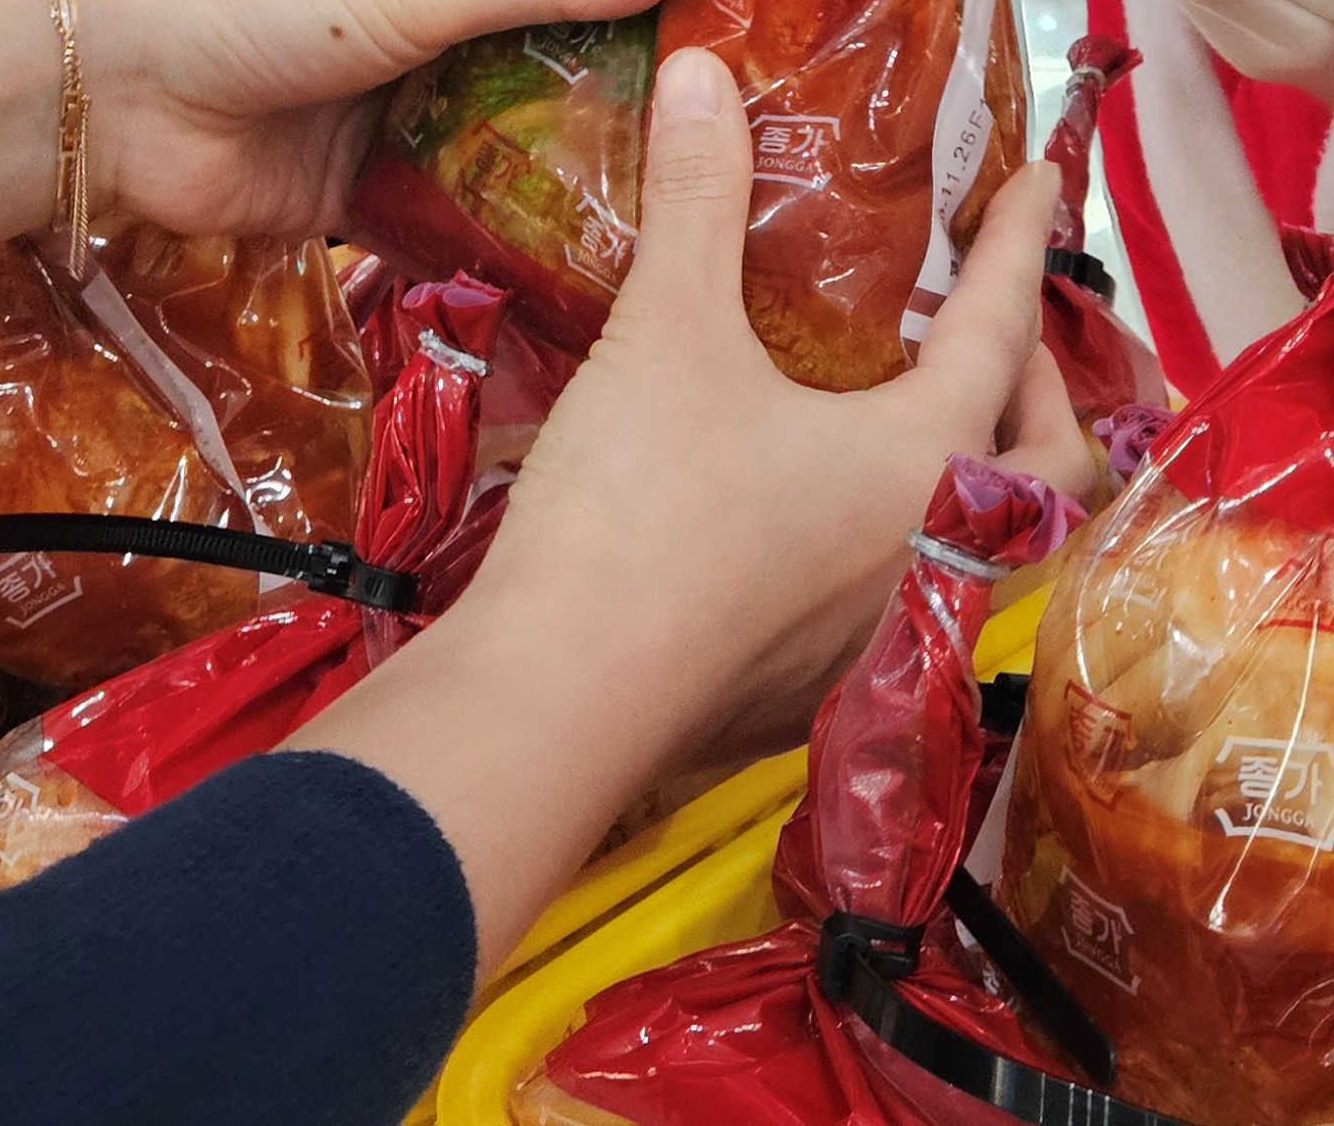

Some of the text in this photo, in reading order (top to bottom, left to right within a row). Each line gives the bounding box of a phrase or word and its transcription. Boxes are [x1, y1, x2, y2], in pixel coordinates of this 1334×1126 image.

[758, 126, 831, 157] 종가
[755, 156, 815, 173] JONGGA
[1238, 756, 1324, 806] 종가
[1242, 802, 1315, 829] JONGGA
